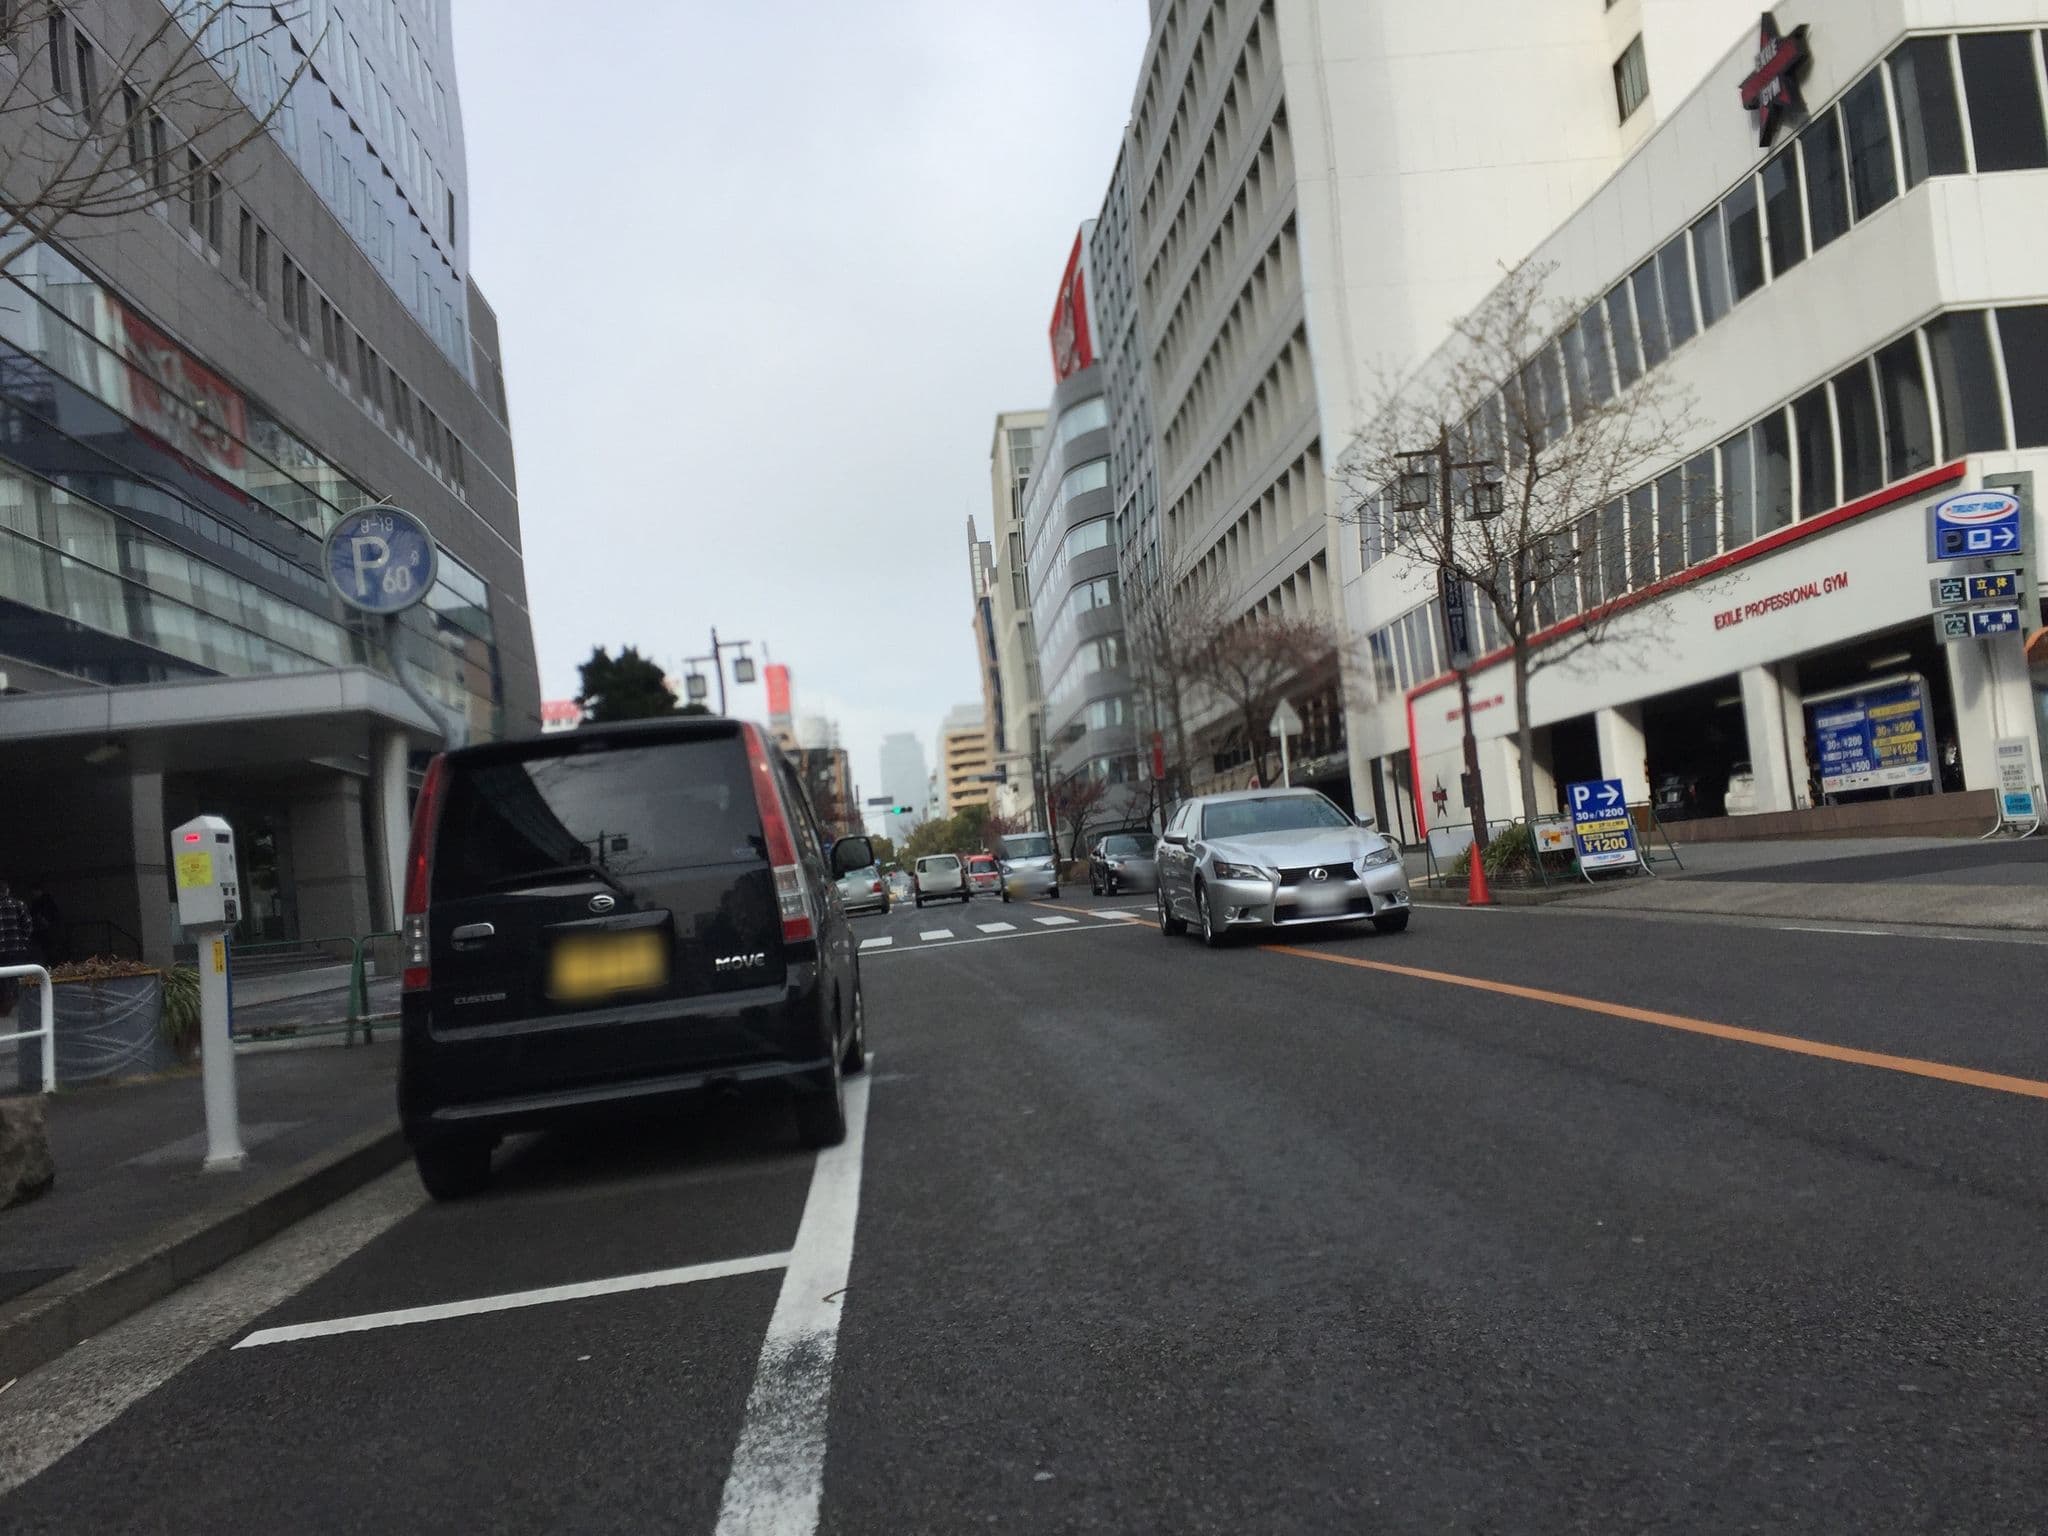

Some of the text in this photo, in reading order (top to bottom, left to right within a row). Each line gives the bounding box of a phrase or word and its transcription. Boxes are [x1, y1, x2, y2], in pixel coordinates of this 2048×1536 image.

[351, 536, 390, 596] P
[383, 566, 410, 593] 60
[1714, 572, 1848, 630] EXILE PROFESSIONAL GYM
[1573, 785, 1591, 811] P
[1585, 837, 1628, 853] ¥1200
[715, 952, 766, 971] MOVE
